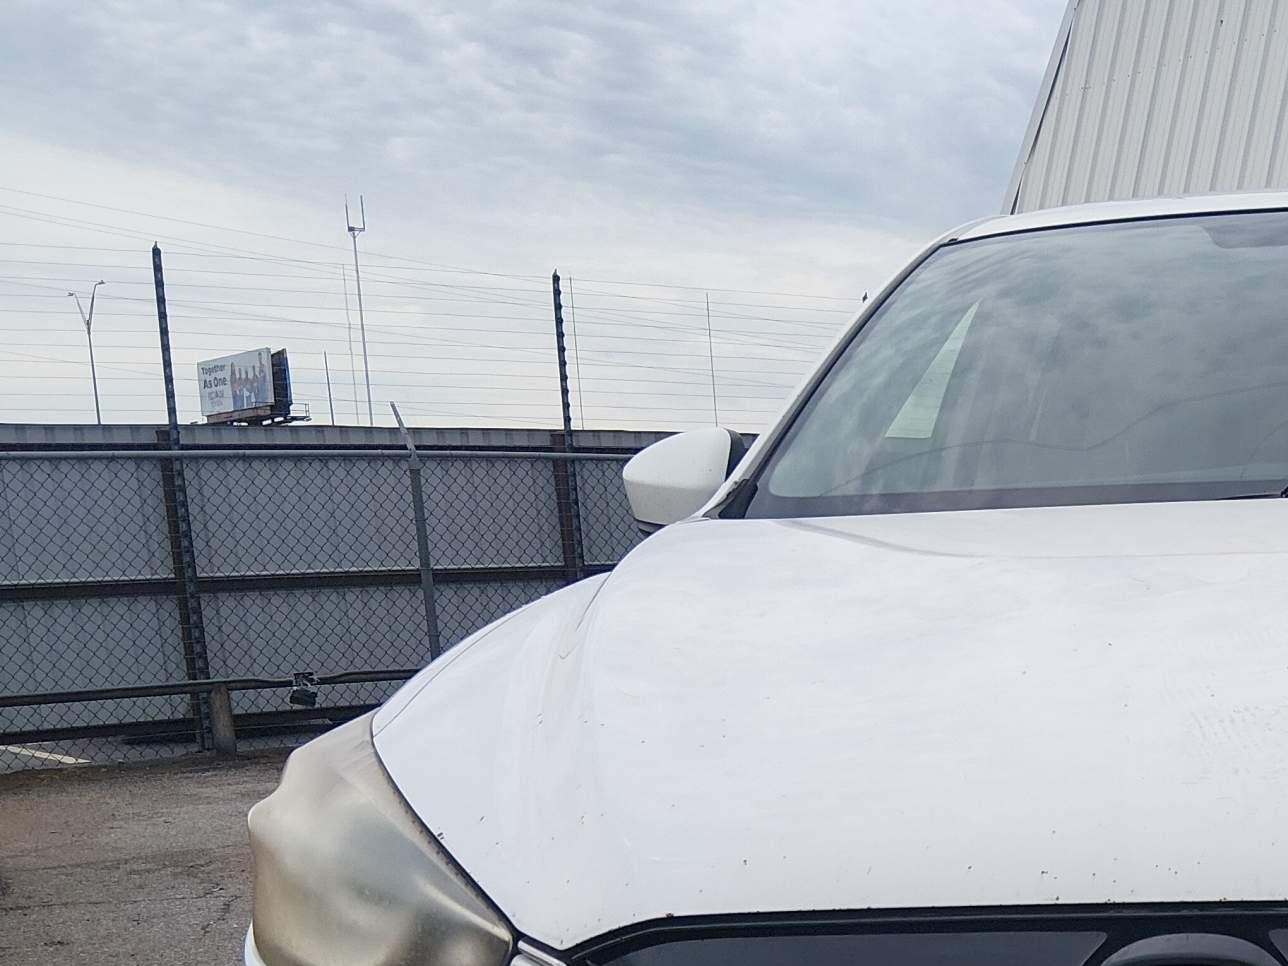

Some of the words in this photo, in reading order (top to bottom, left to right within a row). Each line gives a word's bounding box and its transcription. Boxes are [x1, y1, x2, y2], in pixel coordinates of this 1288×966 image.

[201, 364, 226, 376] Together
[203, 379, 213, 389] As
[213, 376, 228, 387] One
